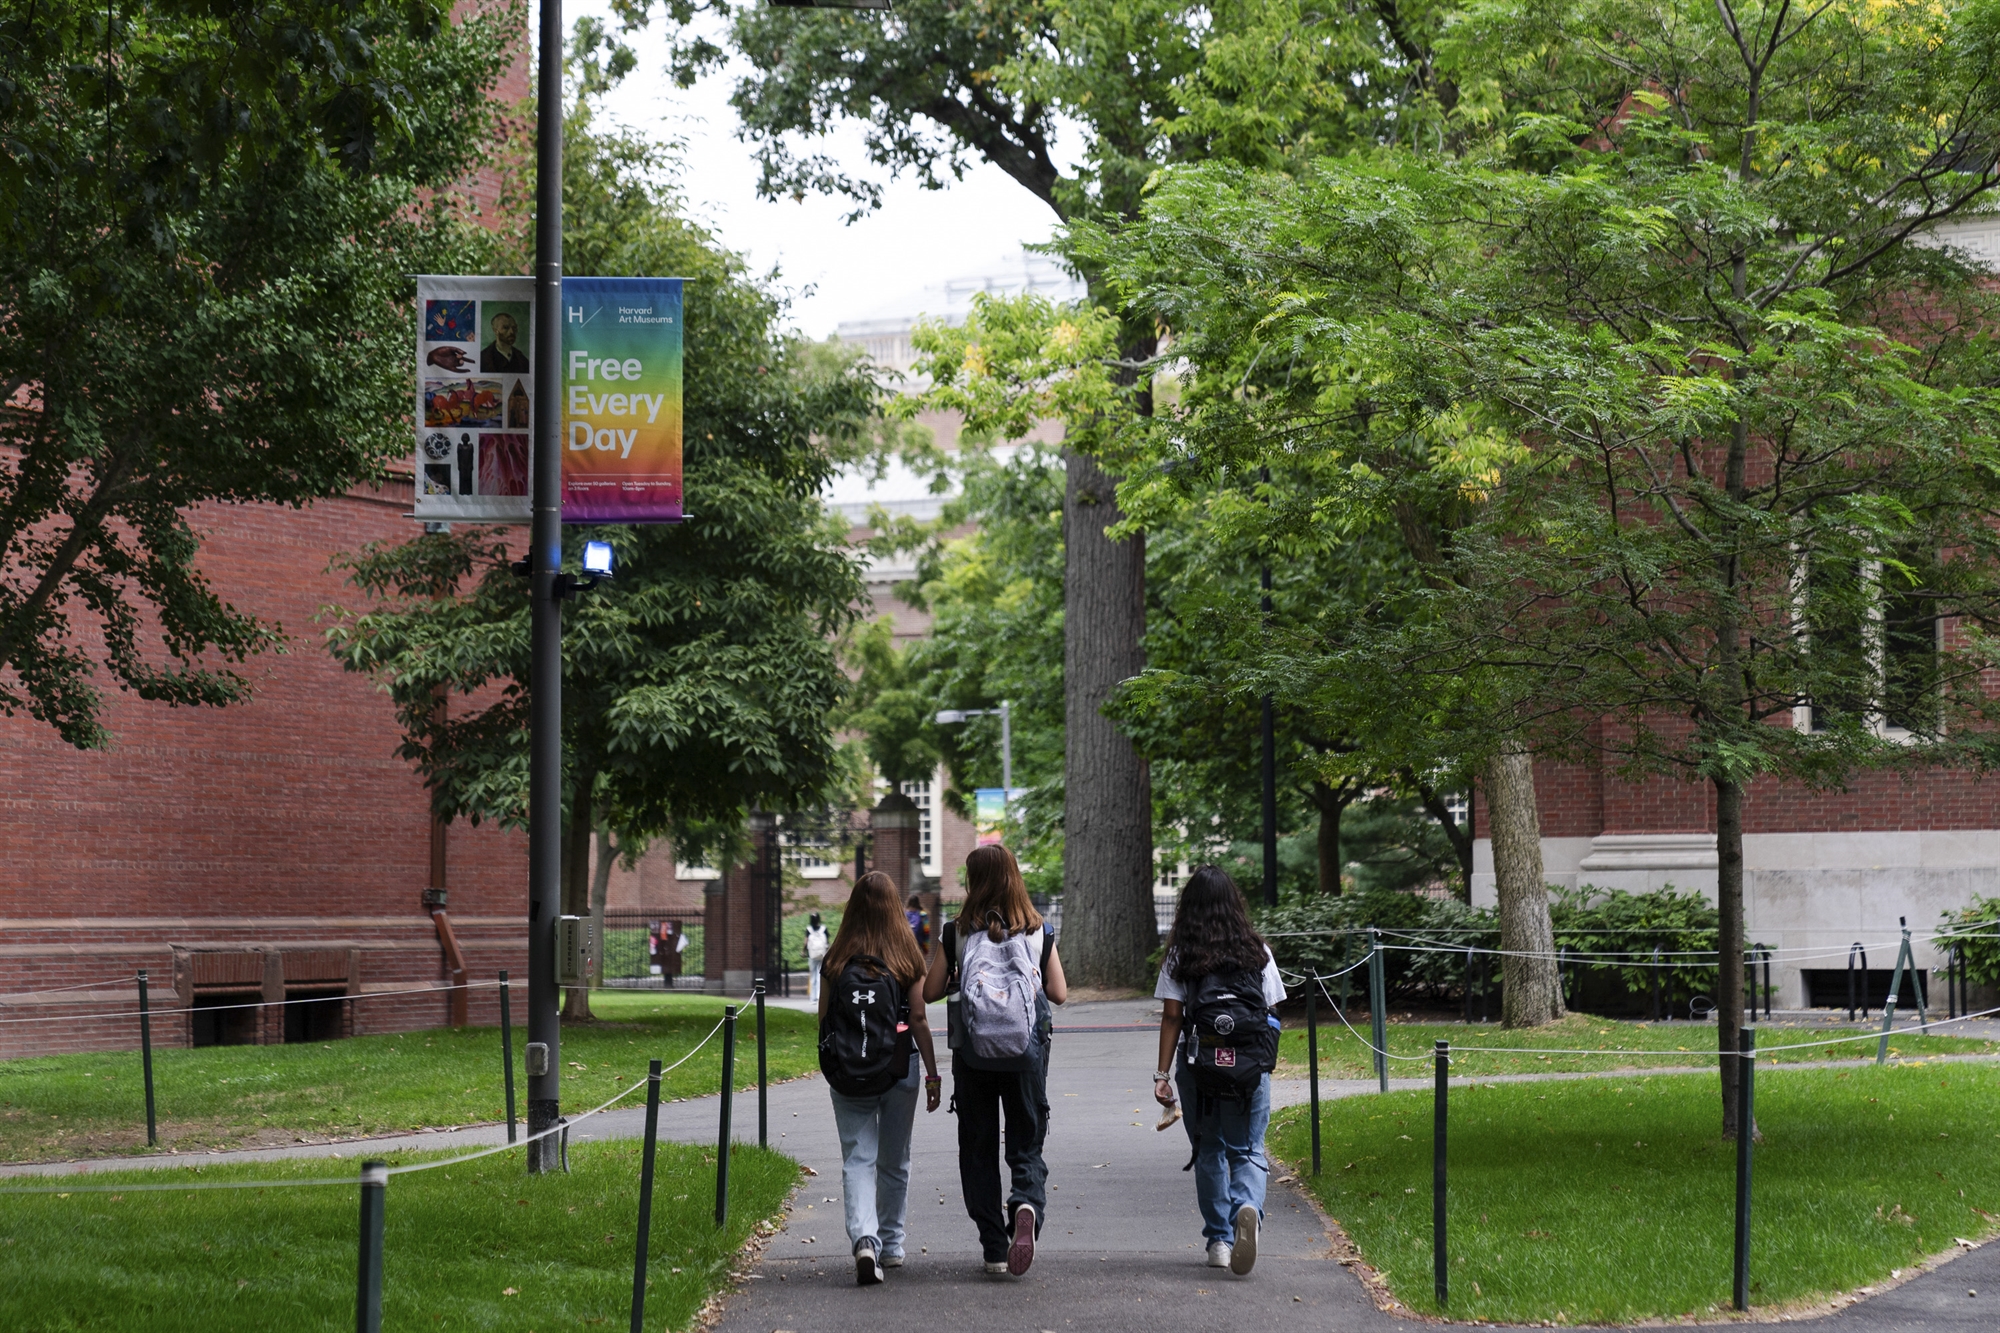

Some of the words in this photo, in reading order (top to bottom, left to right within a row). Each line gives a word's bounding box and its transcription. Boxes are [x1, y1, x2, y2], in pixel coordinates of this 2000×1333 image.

[618, 306, 652, 315] Harvard
[618, 316, 632, 324] Art
[633, 316, 673, 324] Museums
[569, 350, 642, 381] Free
[569, 386, 664, 424] Every
[569, 421, 638, 459] Day
